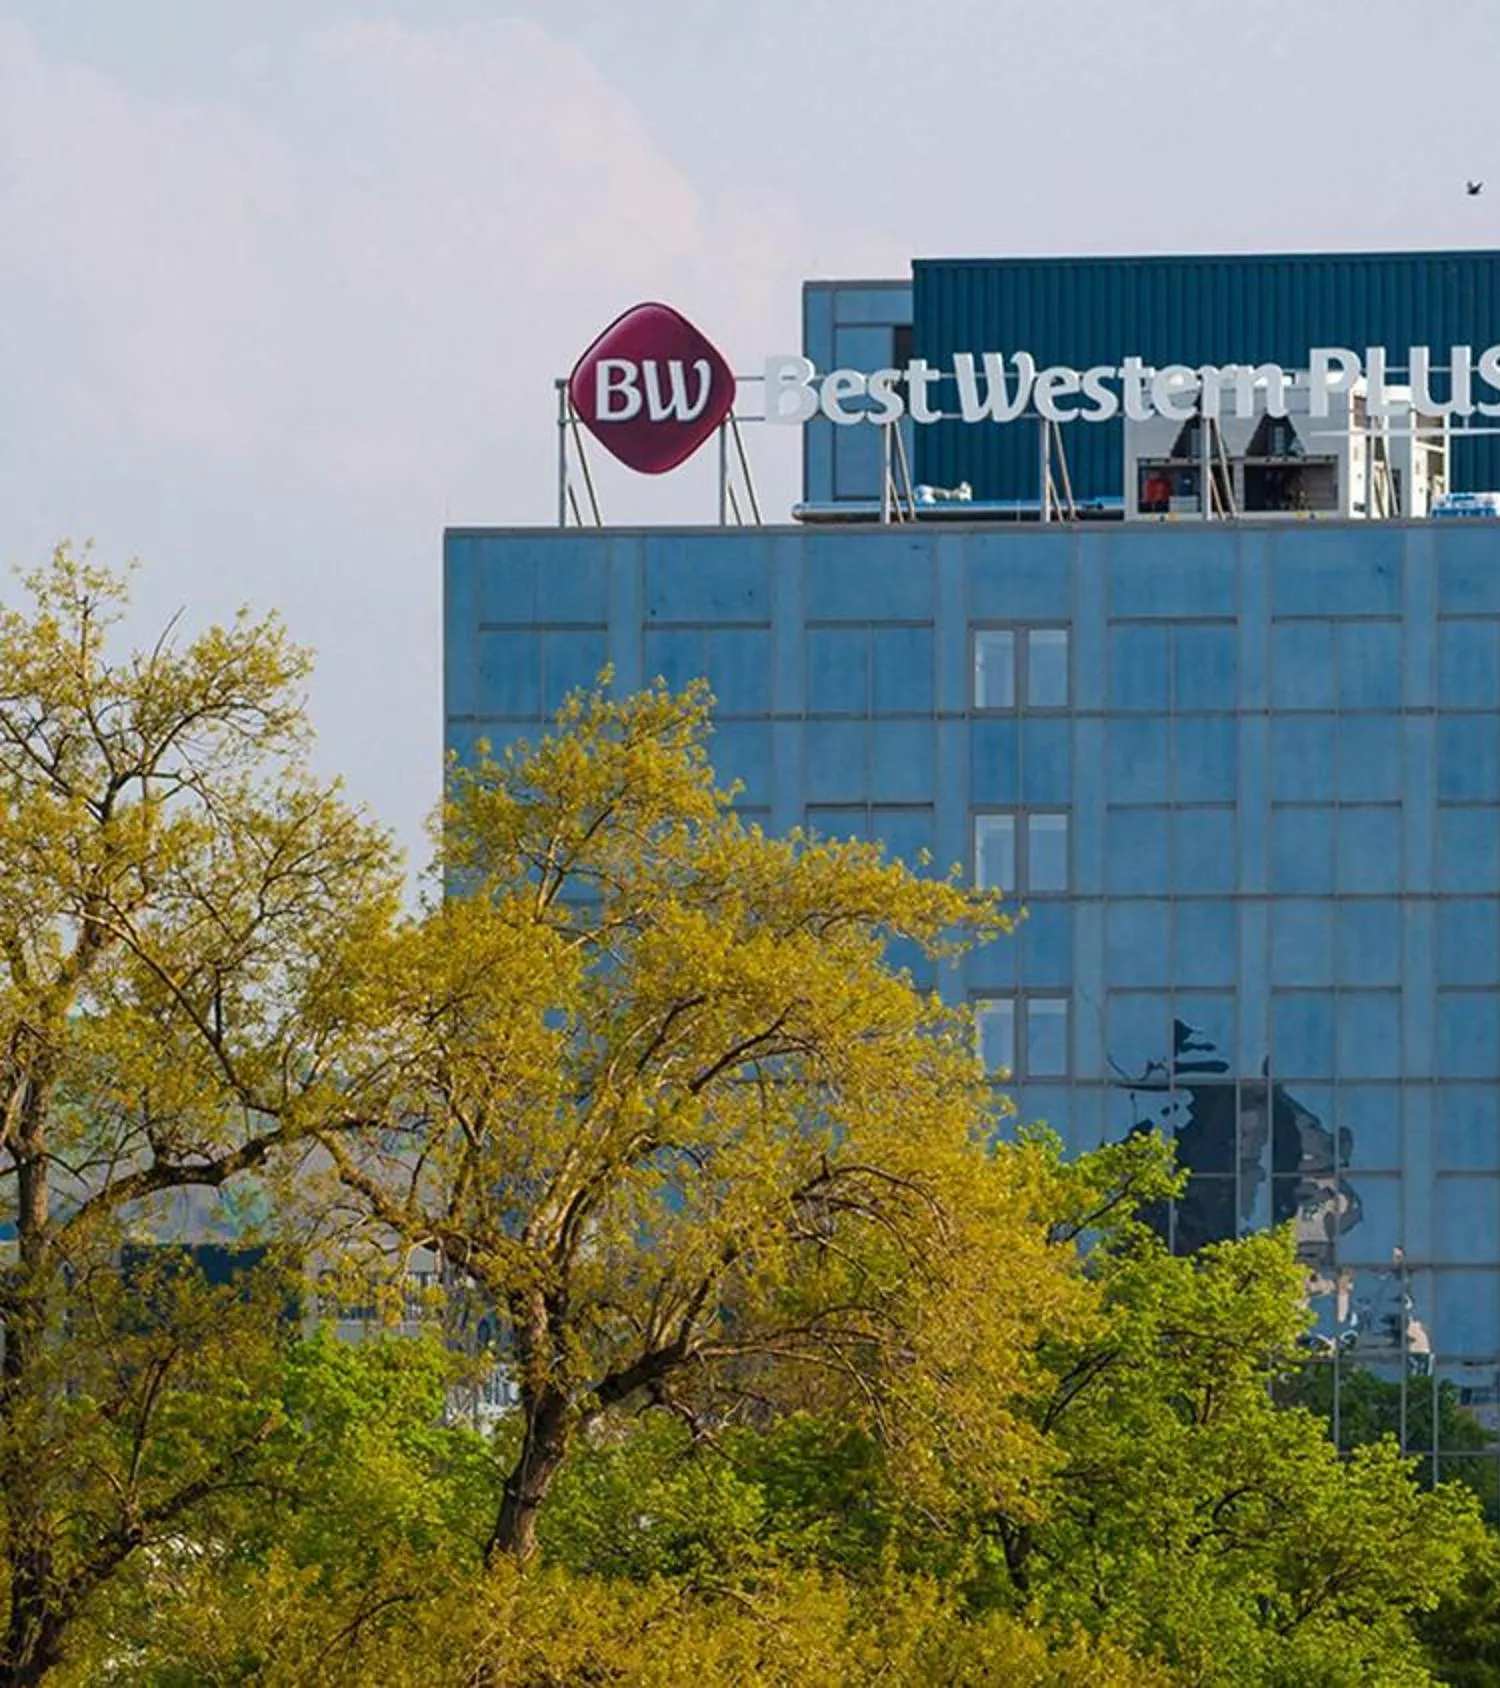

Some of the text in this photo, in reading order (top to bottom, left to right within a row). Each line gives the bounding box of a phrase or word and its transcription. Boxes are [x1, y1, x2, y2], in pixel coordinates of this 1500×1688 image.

[595, 358, 711, 422] BW
[764, 355, 943, 425] Best
[952, 351, 1290, 423] Western
